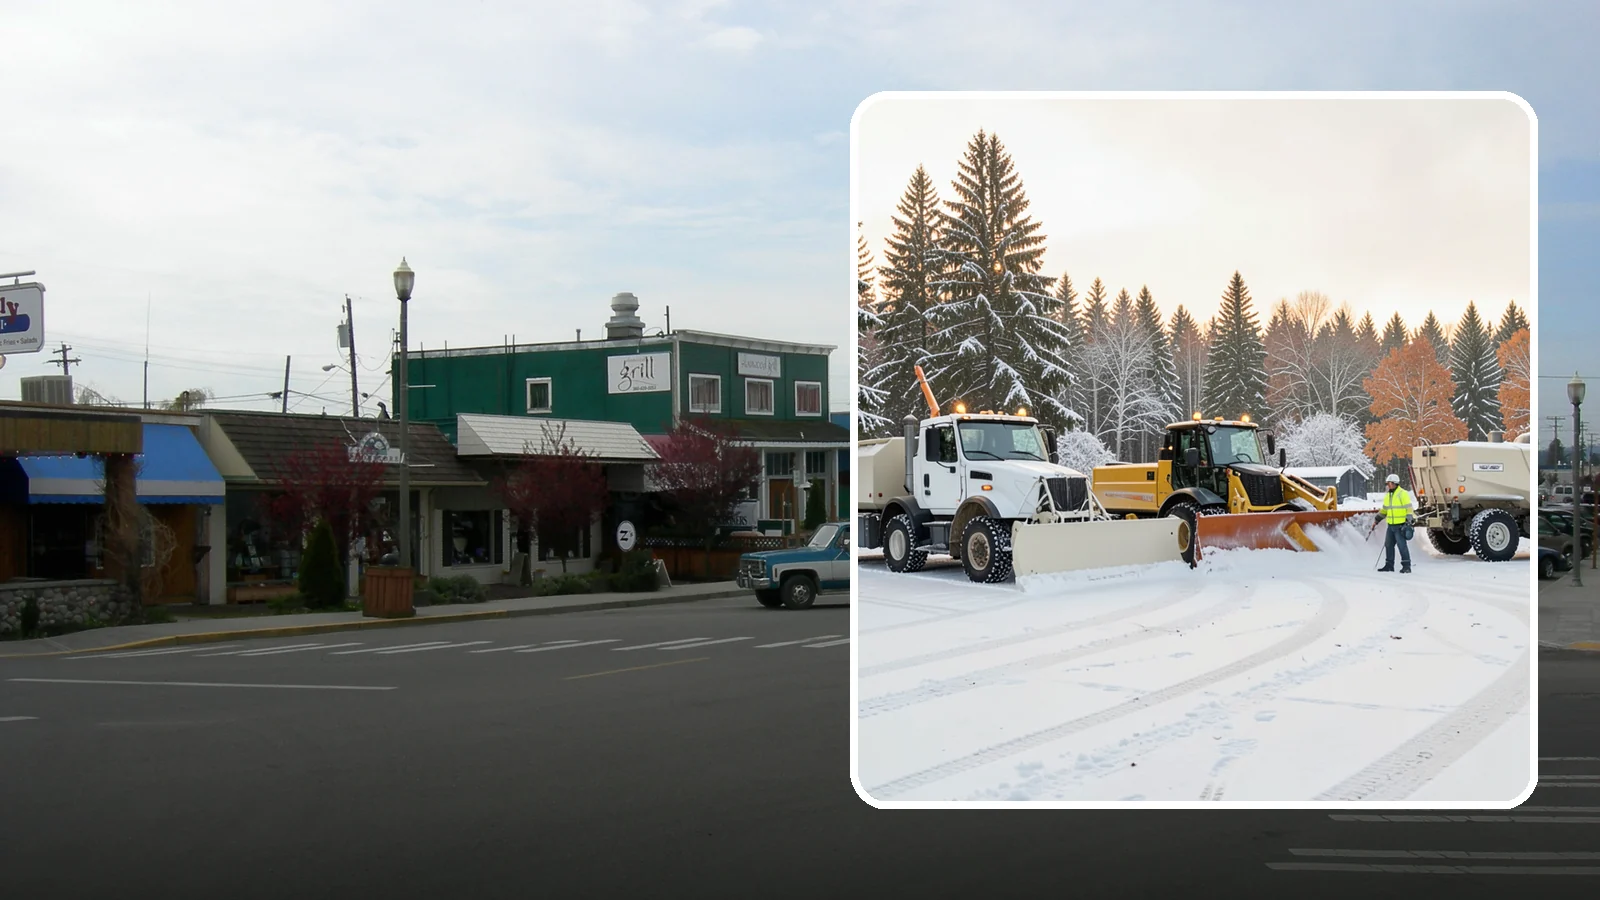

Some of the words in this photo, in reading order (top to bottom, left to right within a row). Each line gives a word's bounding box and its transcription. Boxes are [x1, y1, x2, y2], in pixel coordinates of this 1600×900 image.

[3, 338, 16, 346] Fries
[20, 337, 38, 345] Salads
[617, 355, 655, 392] grill
